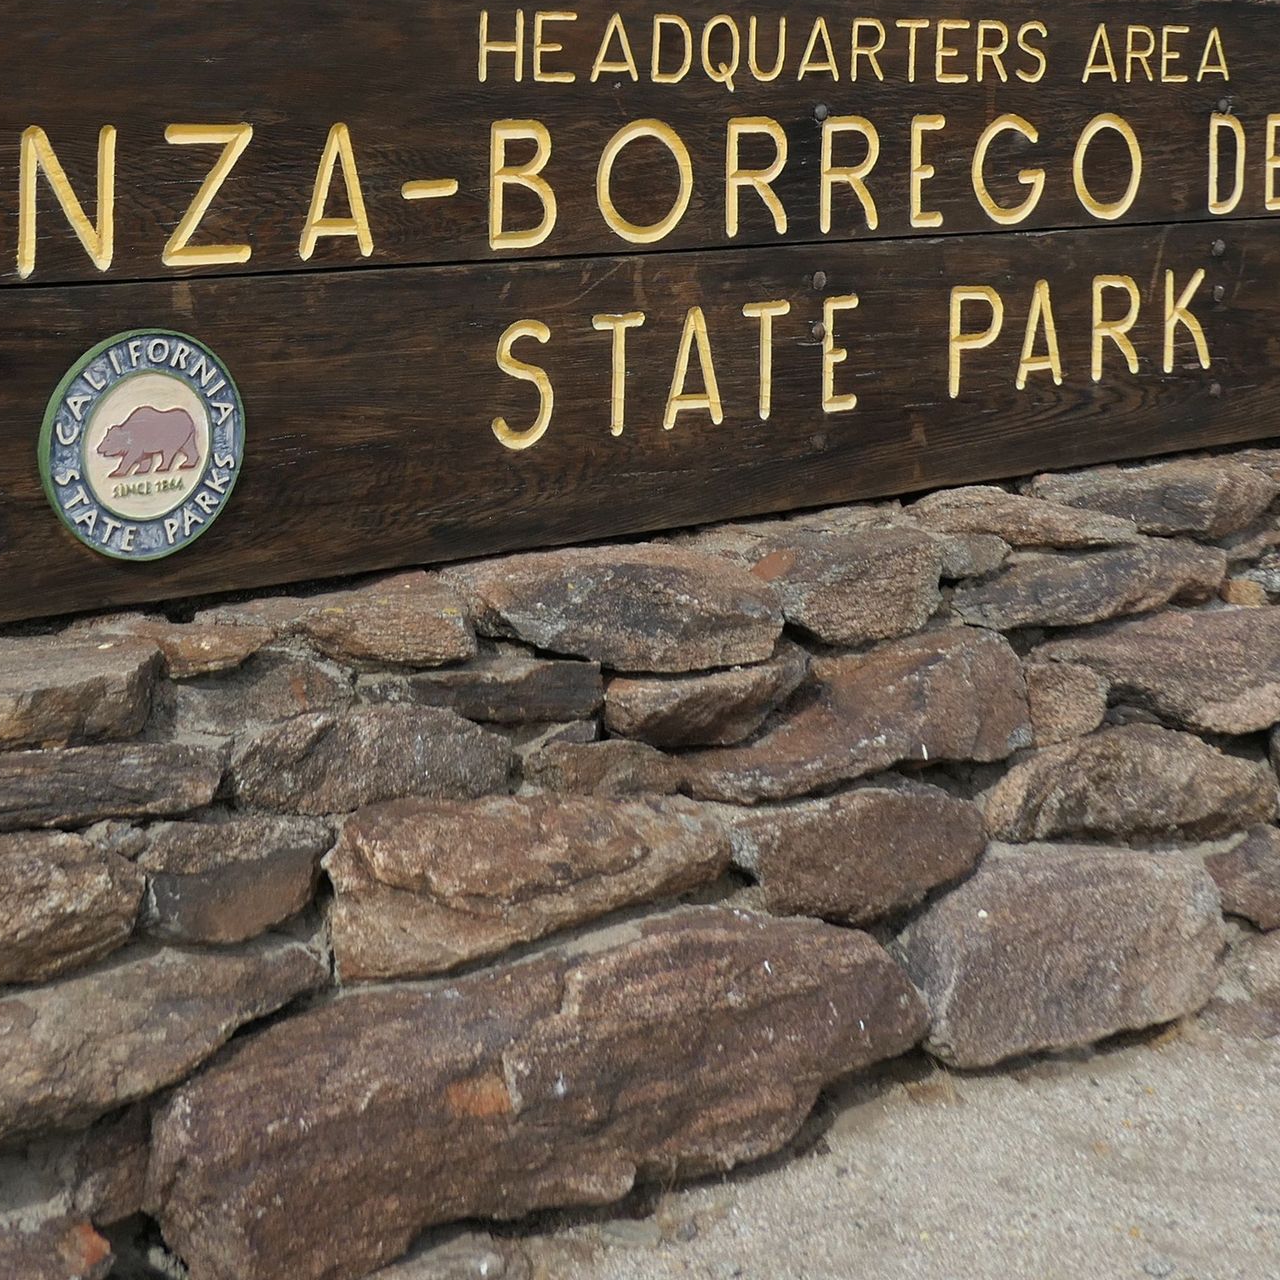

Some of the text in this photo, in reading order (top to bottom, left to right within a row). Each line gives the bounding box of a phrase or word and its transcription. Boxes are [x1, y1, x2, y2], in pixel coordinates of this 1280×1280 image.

[478, 9, 1229, 92] HEADQUARTERS AREA
[57, 339, 234, 446] CALIFORNIA
[492, 268, 1212, 450] STATE PARK
[56, 453, 235, 551] STATE PARKS
[112, 478, 184, 499] SINCE 1864
